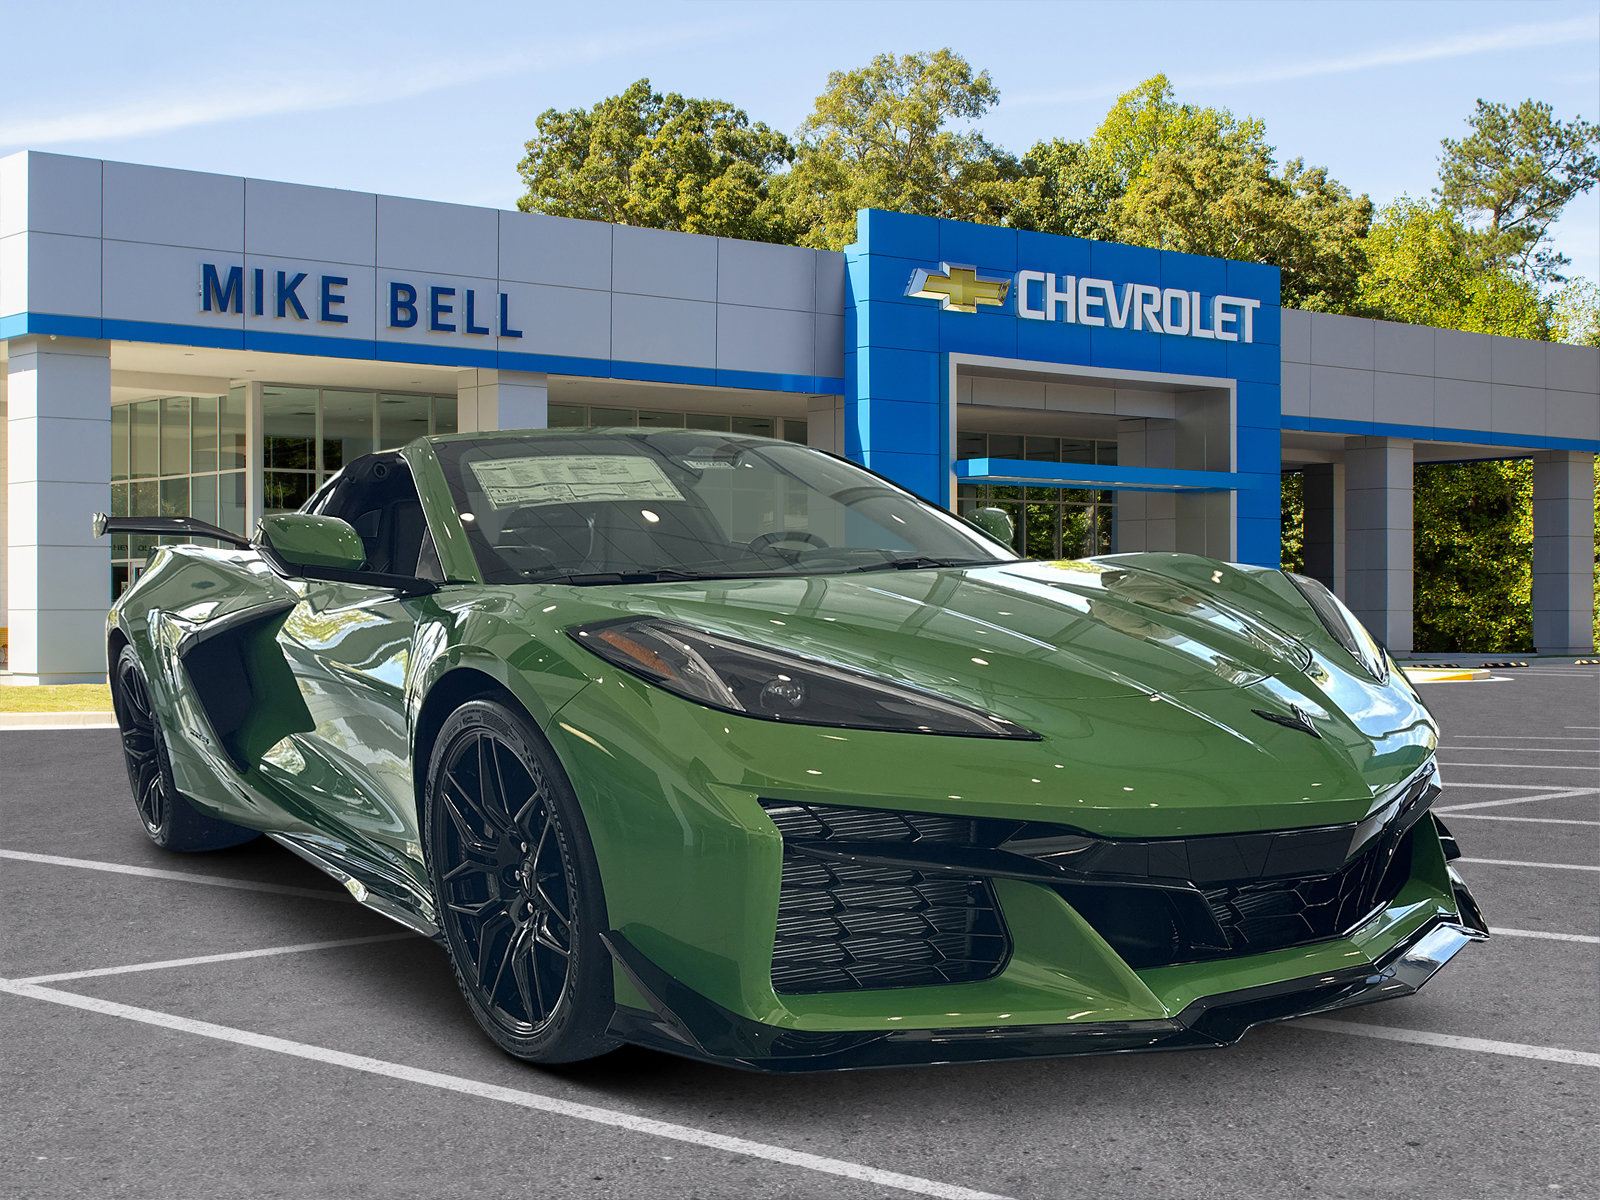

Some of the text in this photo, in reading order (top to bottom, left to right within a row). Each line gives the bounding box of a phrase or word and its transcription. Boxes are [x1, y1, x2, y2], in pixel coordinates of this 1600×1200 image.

[200, 263, 523, 339] MIKE BELL
[1014, 269, 1261, 344] CHEVROLET
